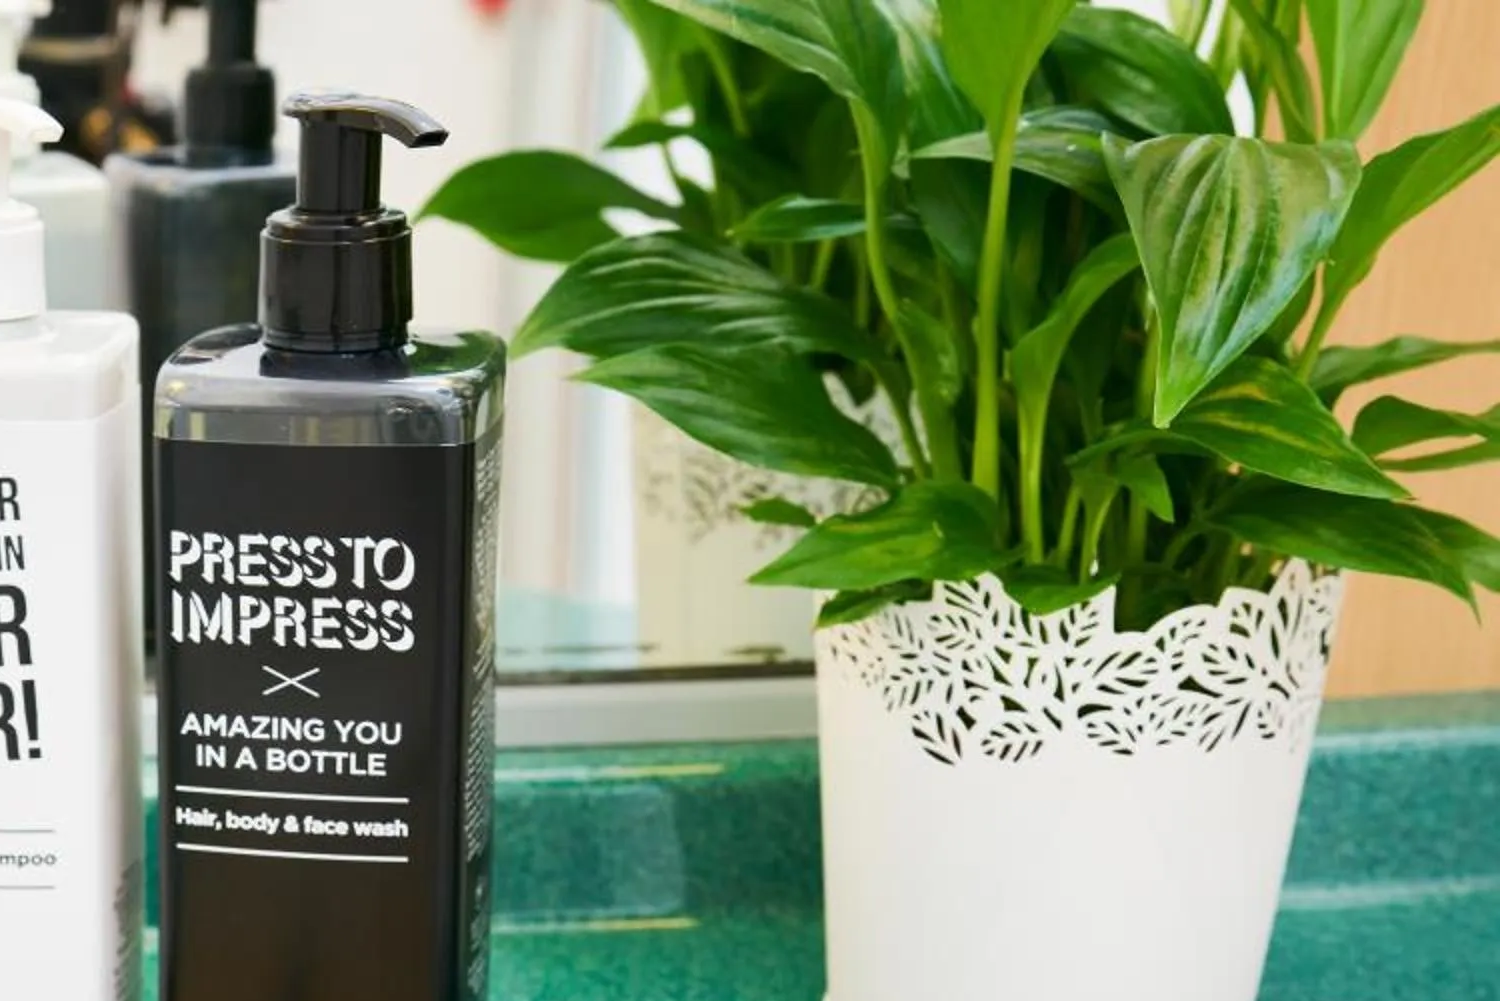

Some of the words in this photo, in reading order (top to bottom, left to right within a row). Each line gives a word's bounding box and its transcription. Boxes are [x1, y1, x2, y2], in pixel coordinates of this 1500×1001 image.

[168, 530, 337, 589] PRESS
[340, 535, 415, 591] TO
[170, 589, 415, 651] IMPRESS
[180, 712, 325, 742] AMAZING
[334, 719, 402, 745] YOU
[195, 744, 226, 768] IN
[235, 747, 258, 771] A
[266, 750, 387, 776] BOTTLE
[175, 807, 222, 830] Hair,
[226, 810, 279, 834] body
[283, 815, 299, 833] &
[303, 815, 349, 836] face
[353, 819, 409, 837] wash
